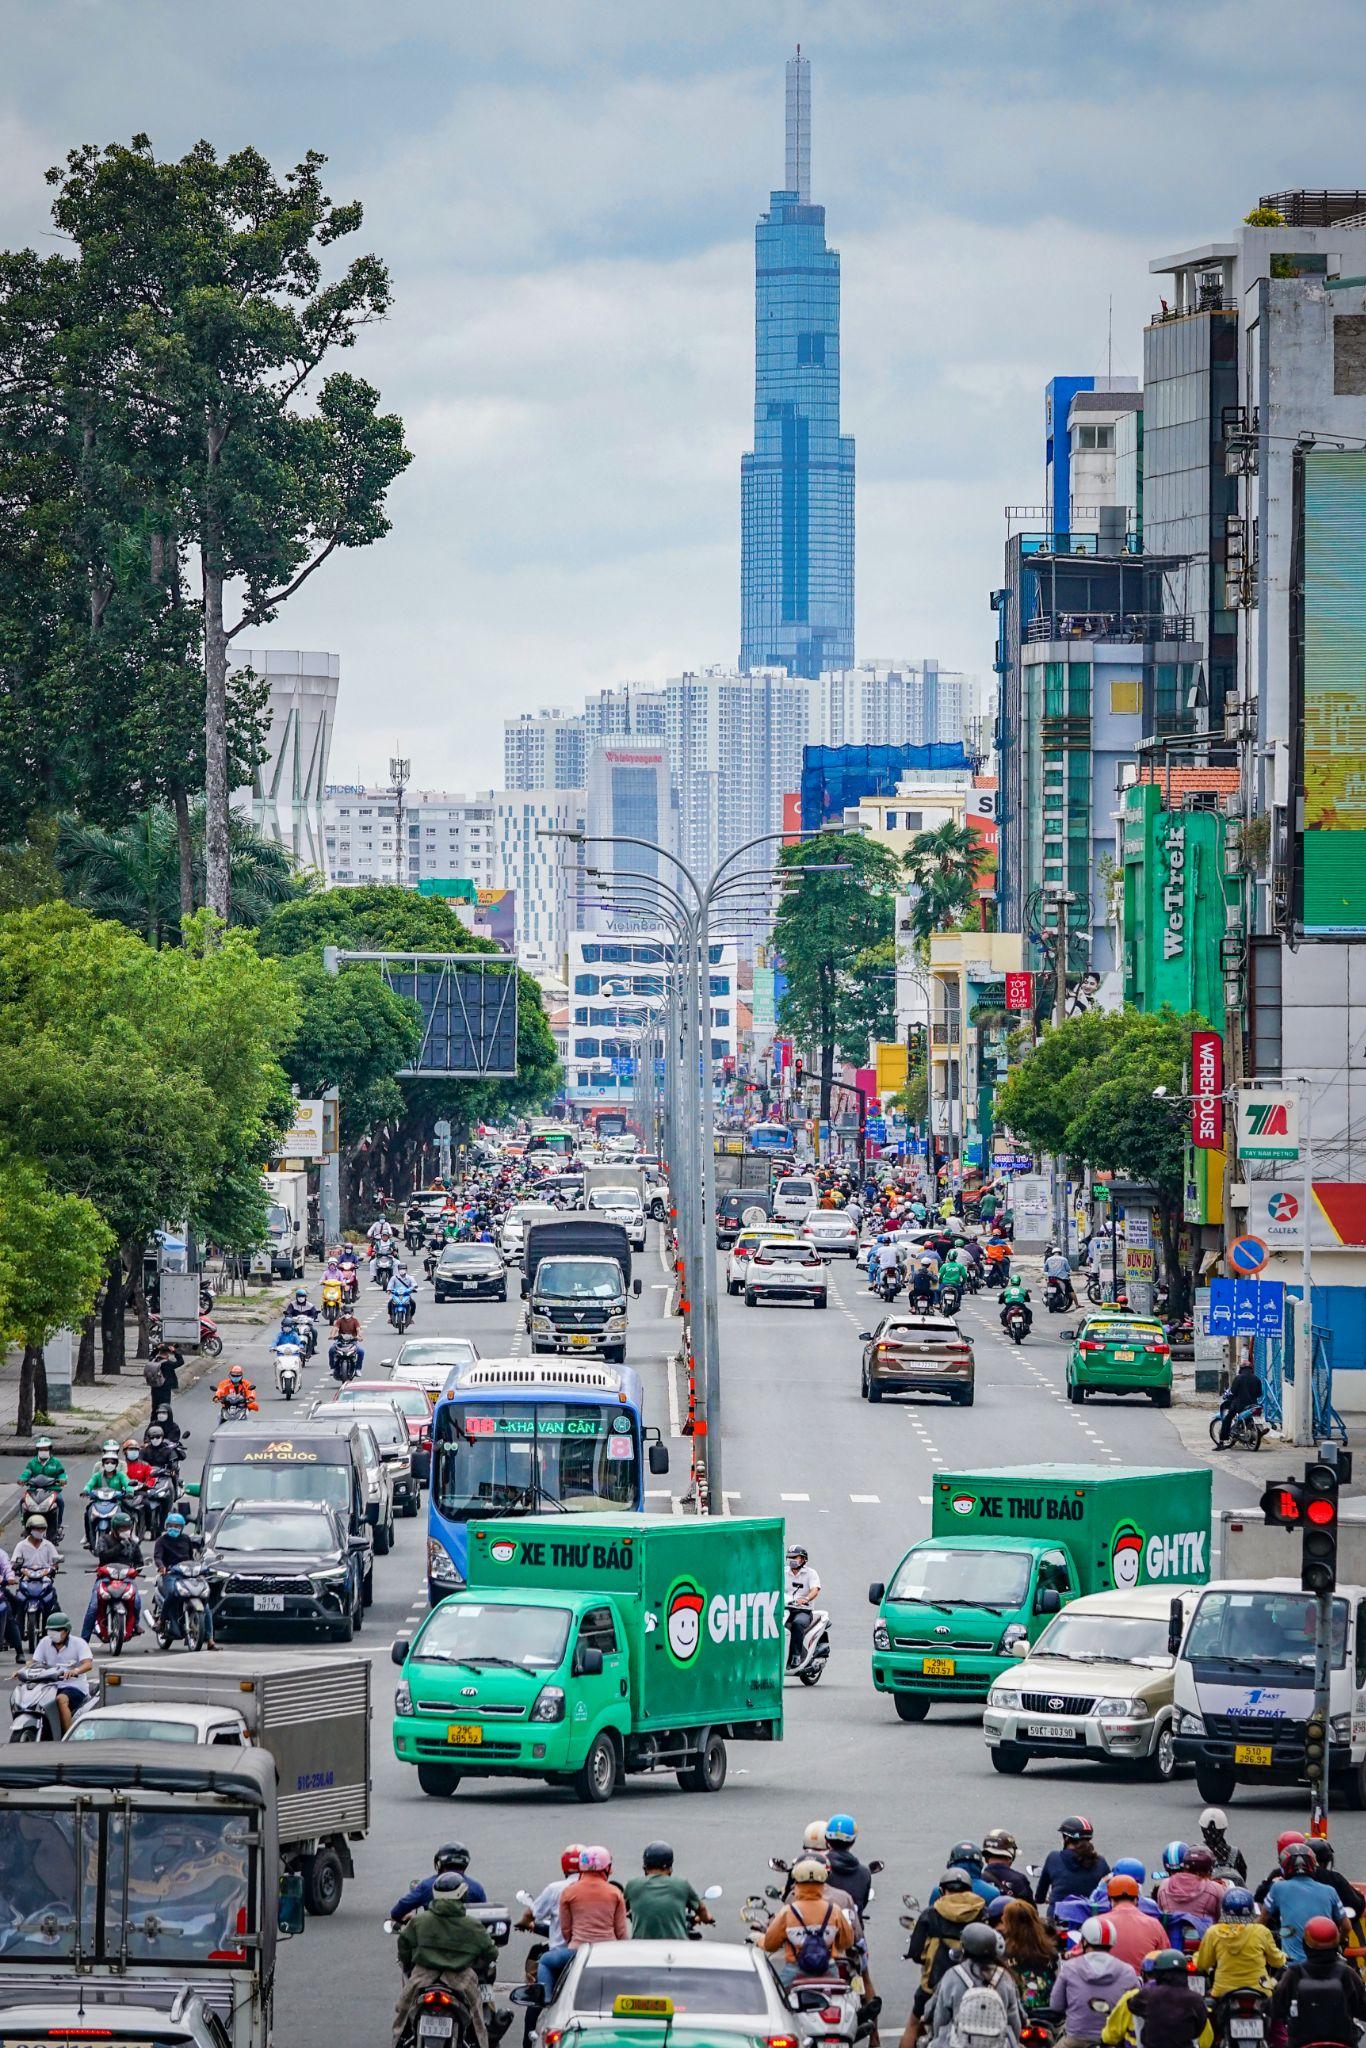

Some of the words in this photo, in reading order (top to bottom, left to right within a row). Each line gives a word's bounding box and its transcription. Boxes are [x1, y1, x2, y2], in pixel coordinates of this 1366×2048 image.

[1163, 825, 1185, 960] WeTrek
[1010, 987, 1025, 998] 01
[1199, 1041, 1215, 1140] WAREHOUSE
[1267, 1226, 1298, 1235] CALTEX
[507, 1421, 534, 1433] KHA
[537, 1422, 564, 1434] VẠN
[243, 1452, 274, 1461] ANH
[979, 1496, 1003, 1518] XE
[1007, 1496, 1044, 1520] THƯ
[1046, 1494, 1084, 1521] BÁO
[519, 1542, 546, 1566] XE
[550, 1541, 591, 1568] THƯ
[592, 1541, 633, 1571] BÁO
[1146, 1530, 1206, 1579] GHTK
[707, 1589, 781, 1644] GHTK
[461, 1688, 475, 1696] KIA
